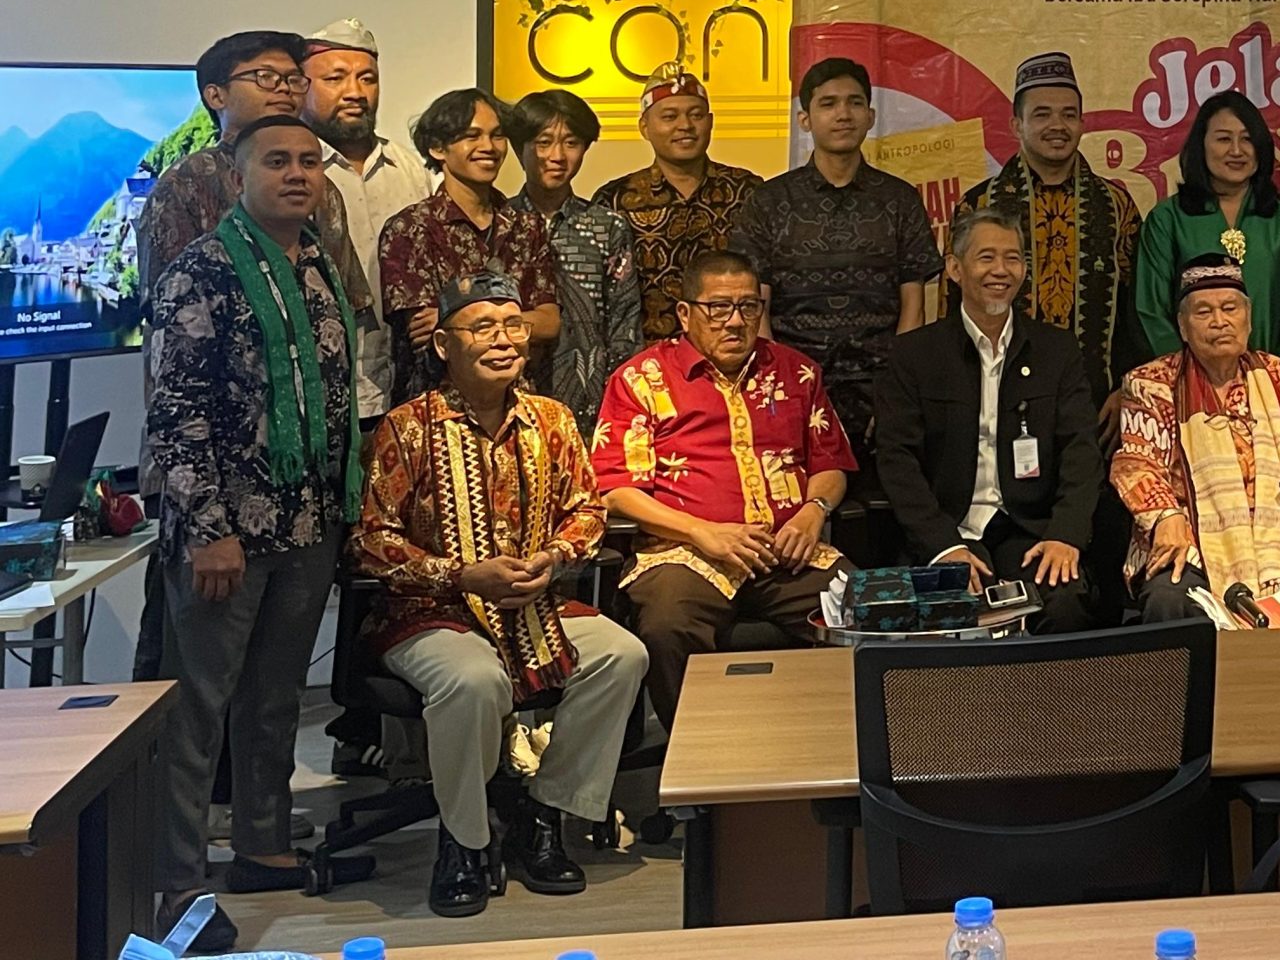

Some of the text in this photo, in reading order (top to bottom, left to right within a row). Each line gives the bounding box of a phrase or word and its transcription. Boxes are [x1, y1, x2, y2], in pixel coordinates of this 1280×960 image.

[527, 5, 792, 84] con
[876, 138, 955, 161] ANTROPOLOGI
[17, 310, 61, 323] No Signal
